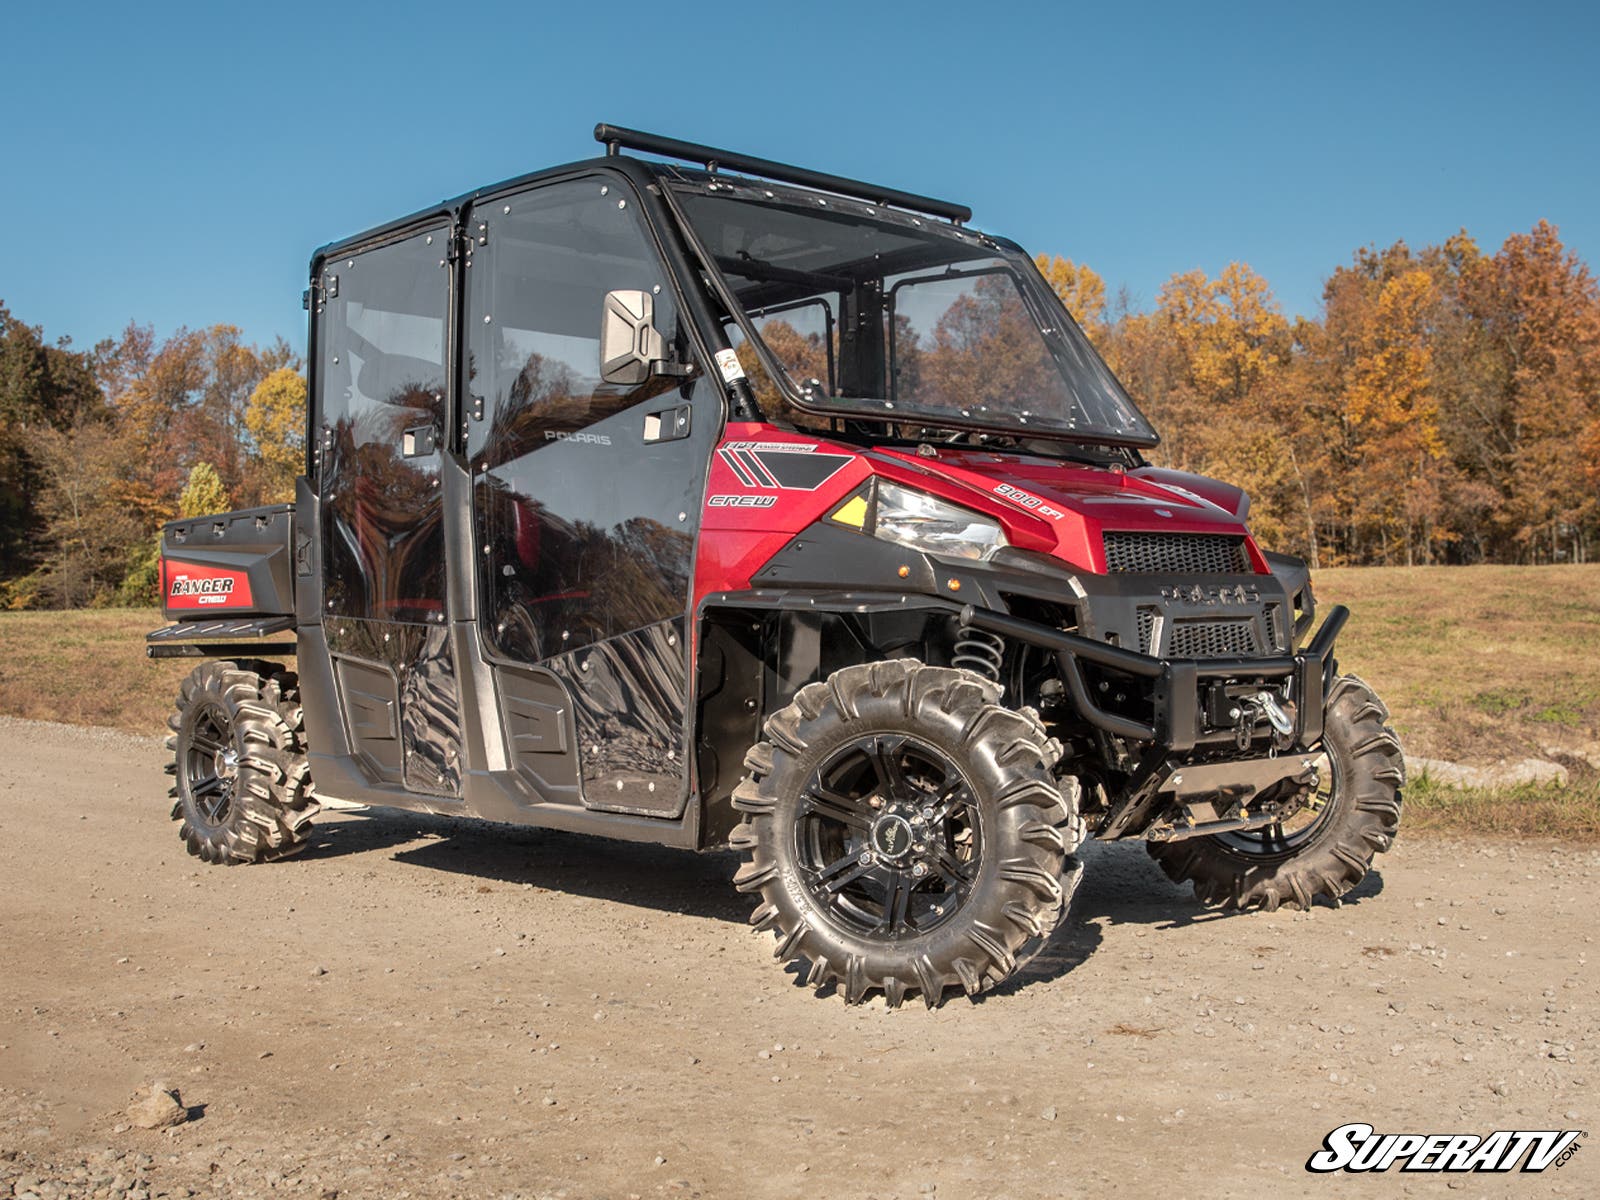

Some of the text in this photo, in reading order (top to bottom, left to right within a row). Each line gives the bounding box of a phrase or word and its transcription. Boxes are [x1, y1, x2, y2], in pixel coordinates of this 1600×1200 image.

[544, 430, 612, 446] POLARIS
[708, 495, 778, 508] CREW
[993, 483, 1043, 509] 900
[170, 577, 234, 596] RANGER
